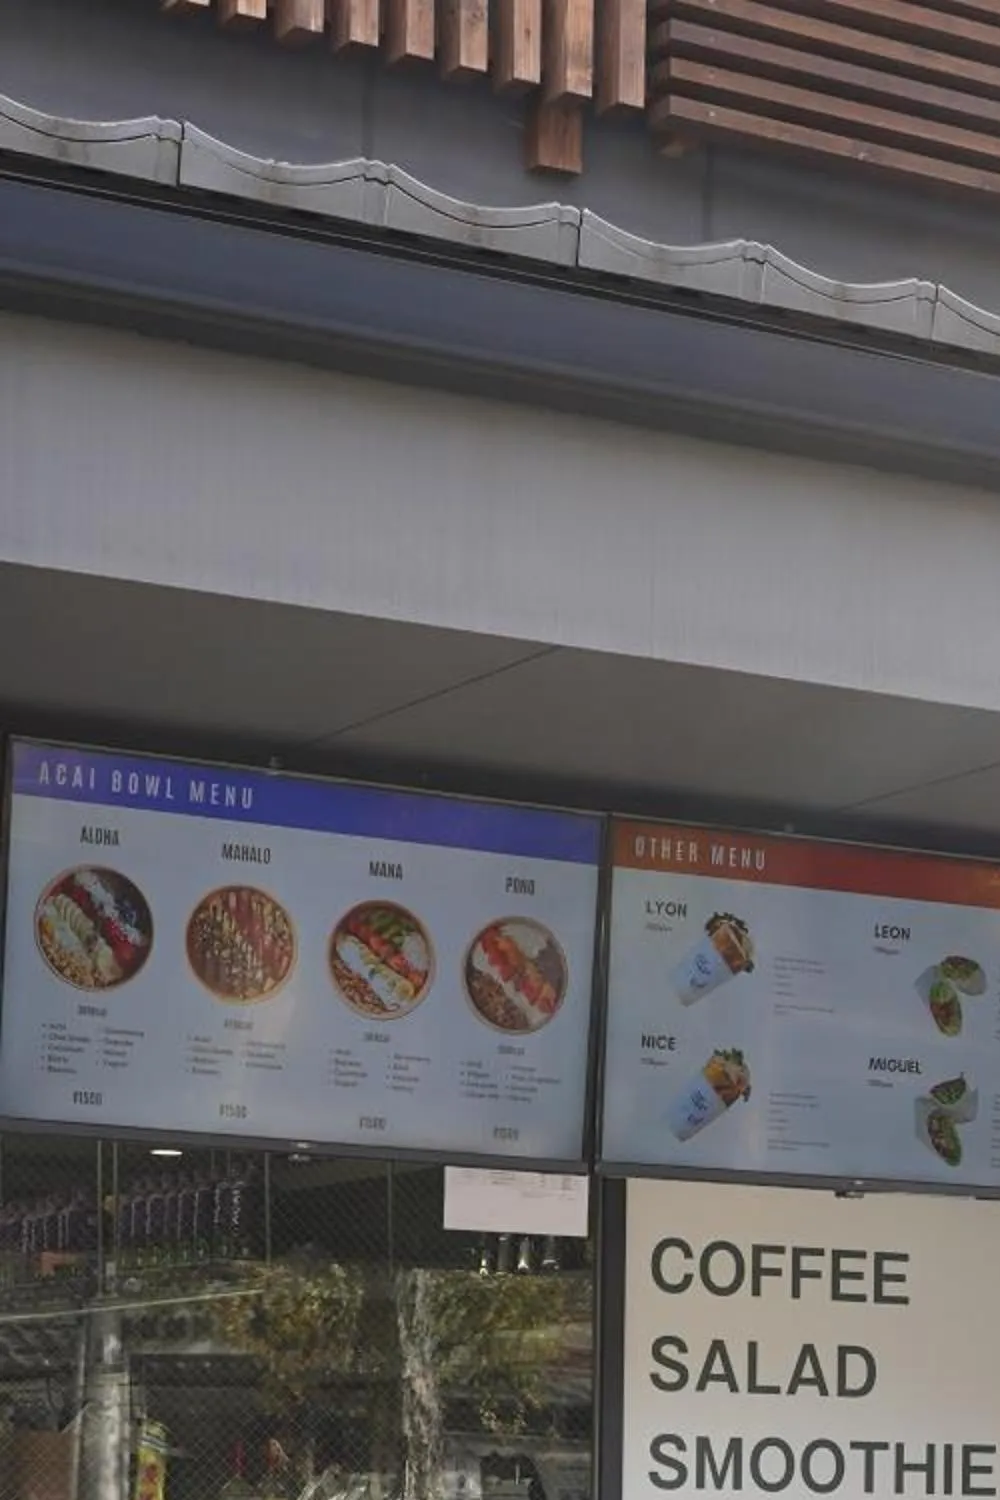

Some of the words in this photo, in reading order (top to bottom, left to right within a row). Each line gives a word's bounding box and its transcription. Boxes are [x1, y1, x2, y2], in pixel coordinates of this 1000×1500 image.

[111, 770, 174, 800] BOWL
[189, 780, 254, 809] MENU
[221, 843, 271, 865] MAHALO
[635, 835, 698, 863] OTHER
[711, 845, 766, 871] MENU
[645, 900, 687, 918] LYON
[874, 923, 911, 940] LEON
[640, 1033, 677, 1050] NICE
[868, 1057, 922, 1075] MIGUEL
[650, 1237, 910, 1305] COFFEE
[649, 1335, 878, 1398] SALAD
[648, 1433, 997, 1497] SMOOTHIE
